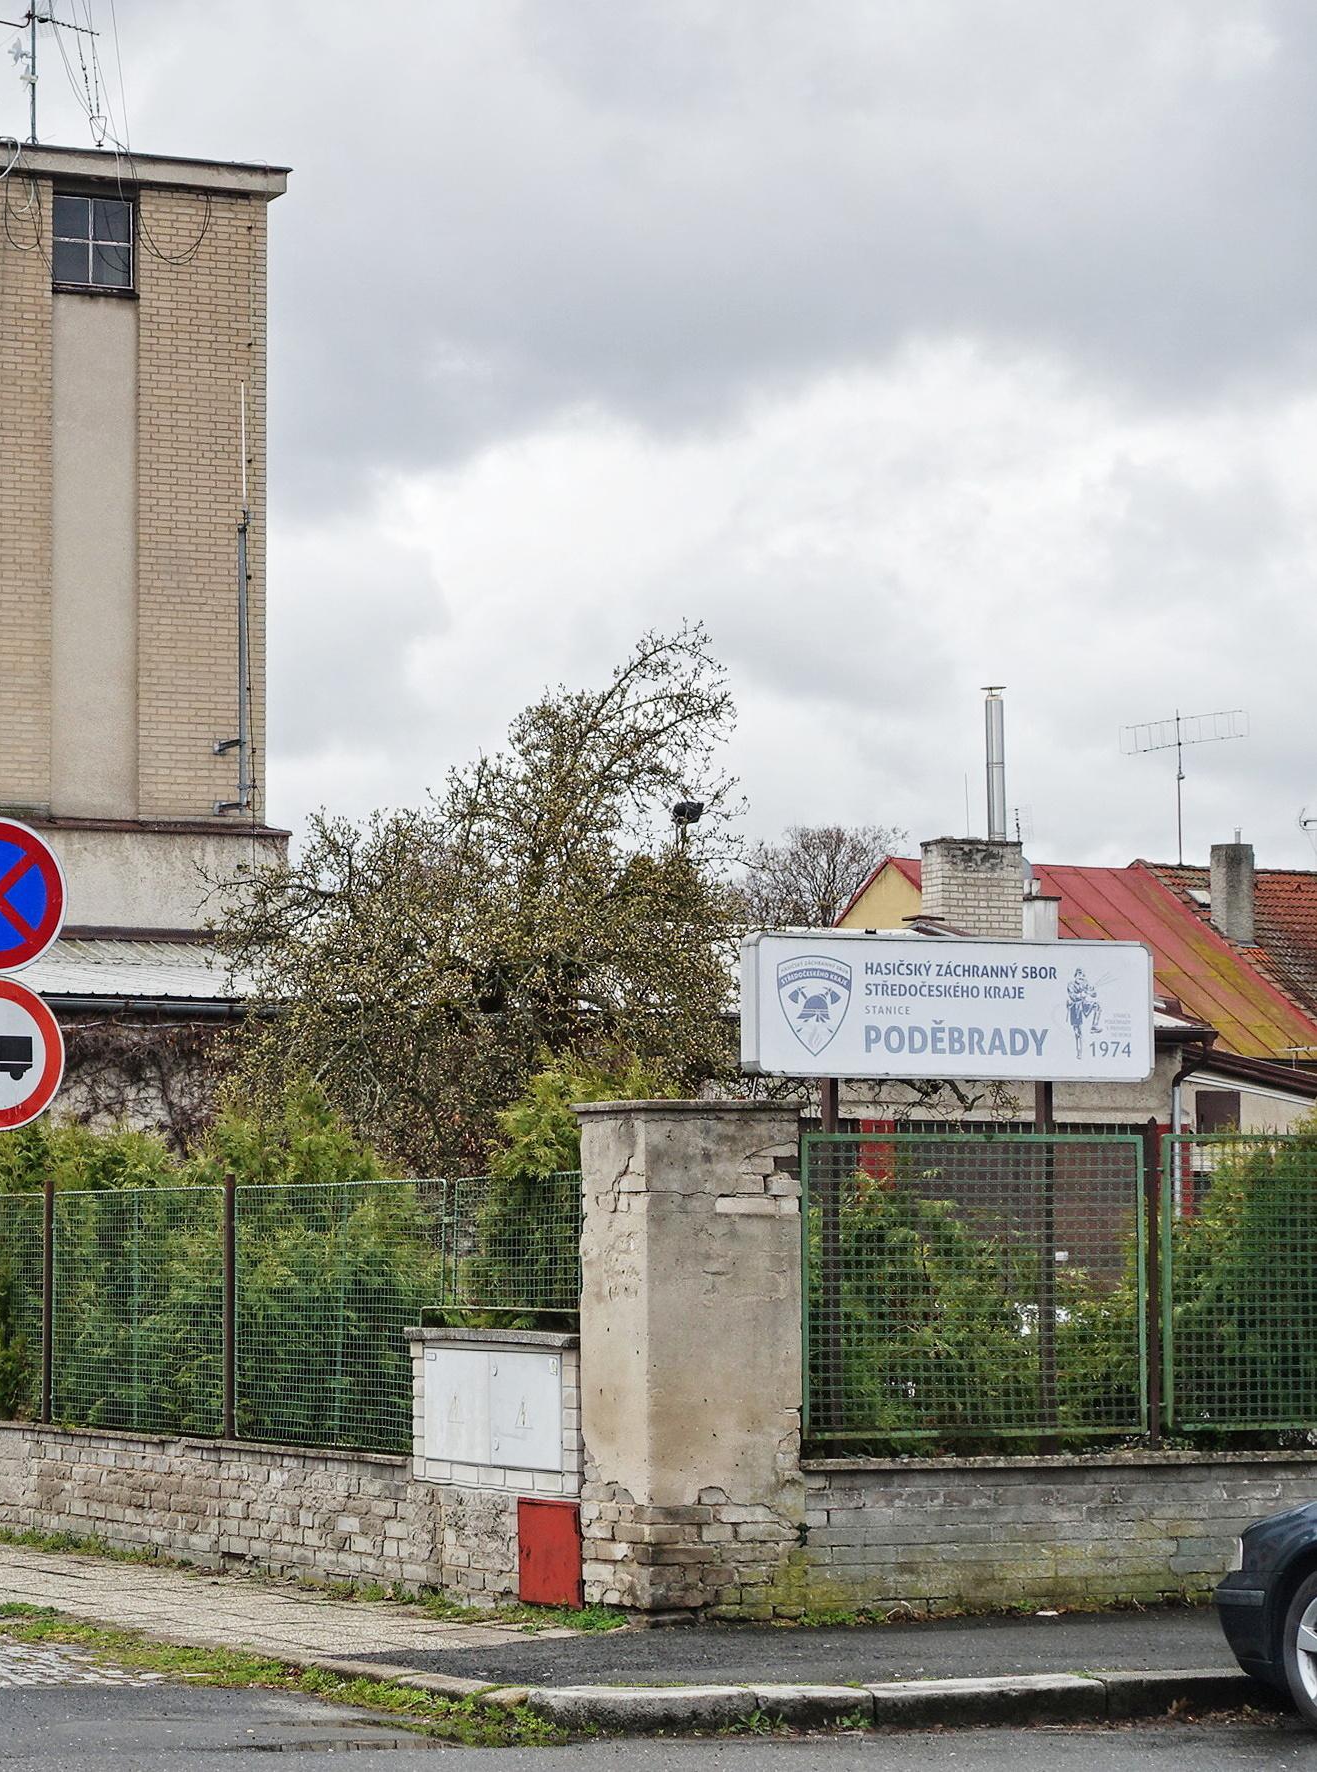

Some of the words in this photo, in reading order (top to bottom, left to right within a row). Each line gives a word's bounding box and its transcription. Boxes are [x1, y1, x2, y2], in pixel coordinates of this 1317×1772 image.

[865, 959, 932, 977] HASIČSKÝ
[935, 960, 1018, 979] ZÁCHRANNÝ
[1021, 965, 1058, 980] SBOR
[829, 973, 849, 986] KRAJE
[865, 980, 980, 998] STŘEDOČESKÉHO
[983, 985, 1026, 999] KRAJE
[864, 1005, 911, 1015] STANICE
[864, 1019, 1050, 1057] PODĚBRADY
[1089, 1040, 1132, 1058] 1974
